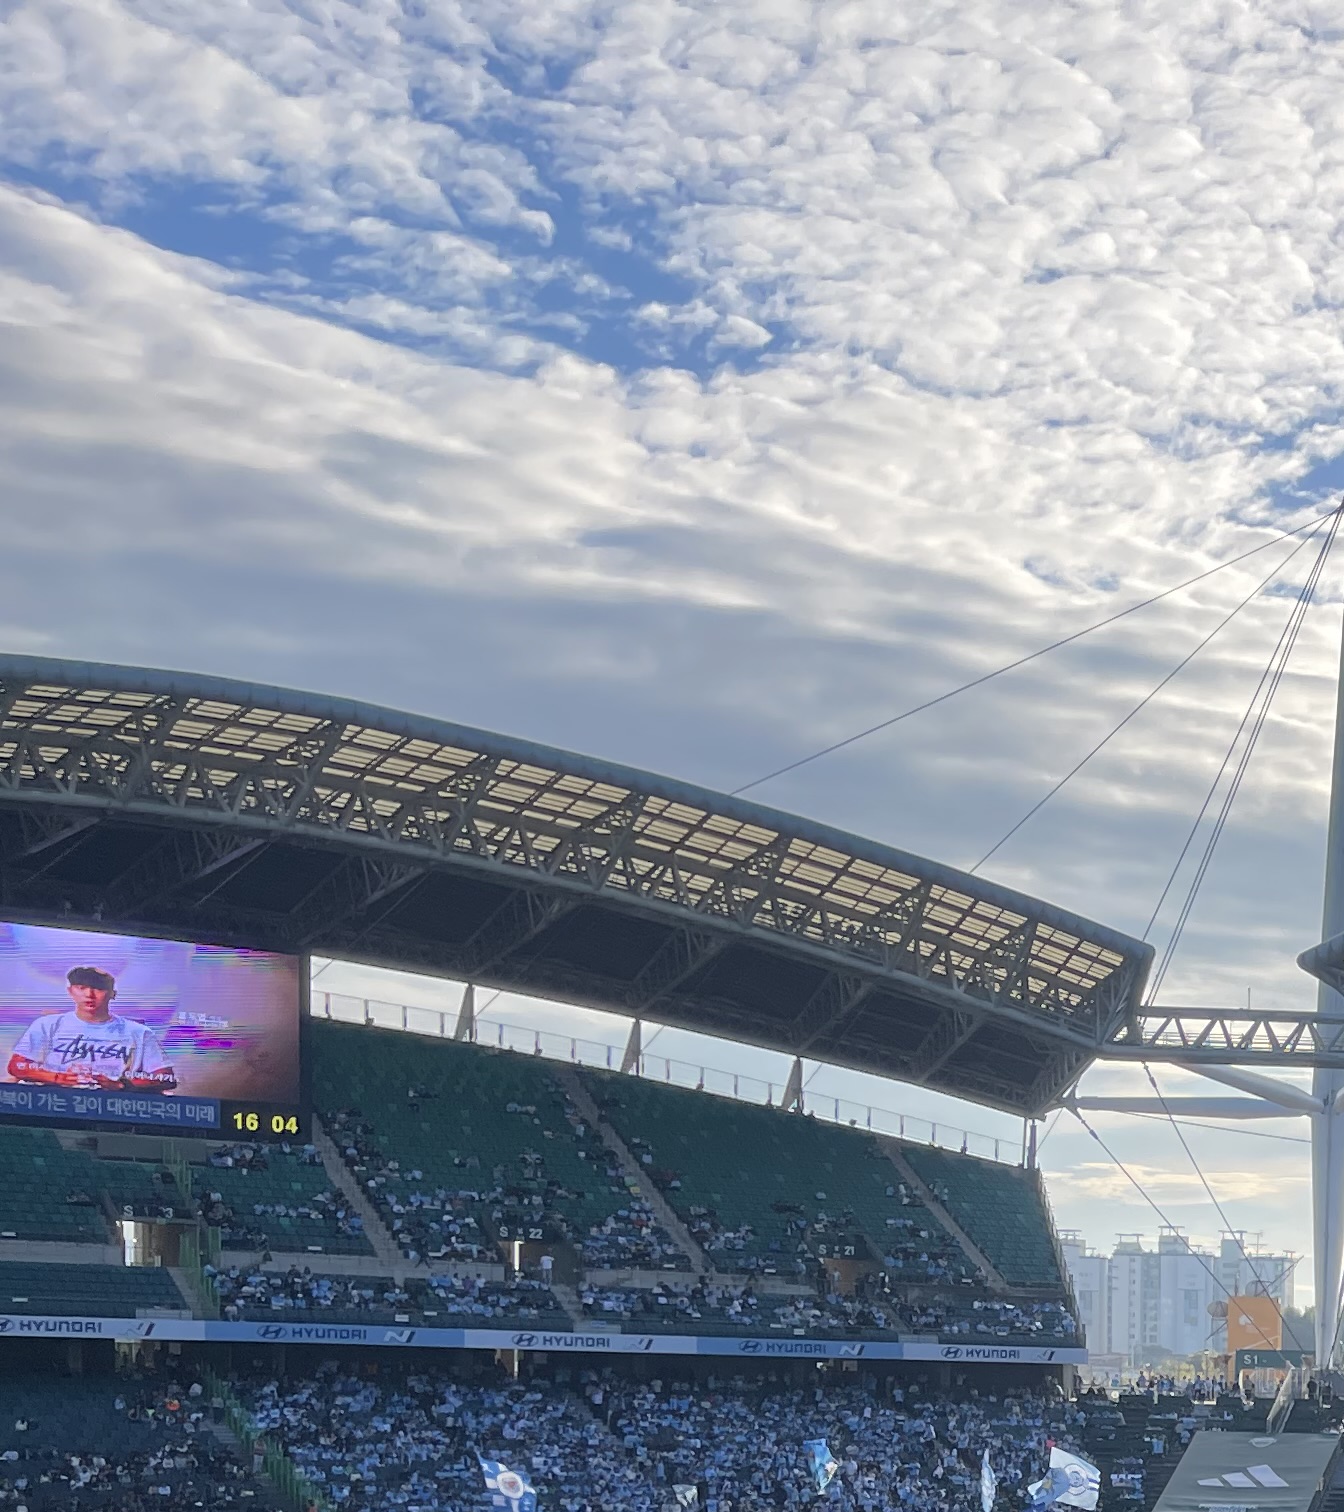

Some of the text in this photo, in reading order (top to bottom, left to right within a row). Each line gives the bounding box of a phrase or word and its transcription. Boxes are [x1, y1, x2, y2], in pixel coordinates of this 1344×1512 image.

[0, 1090, 215, 1123] 북이 가는 길이 대한민국의 미래
[232, 1112, 298, 1134] 16 04
[19, 1320, 102, 1334] HYUNDAI
[292, 1328, 367, 1340] HYUNDAI
[542, 1335, 610, 1348] HYUNDAI
[765, 1342, 827, 1354] HYUNDAI
[964, 1348, 1019, 1360] HYUNDAI
